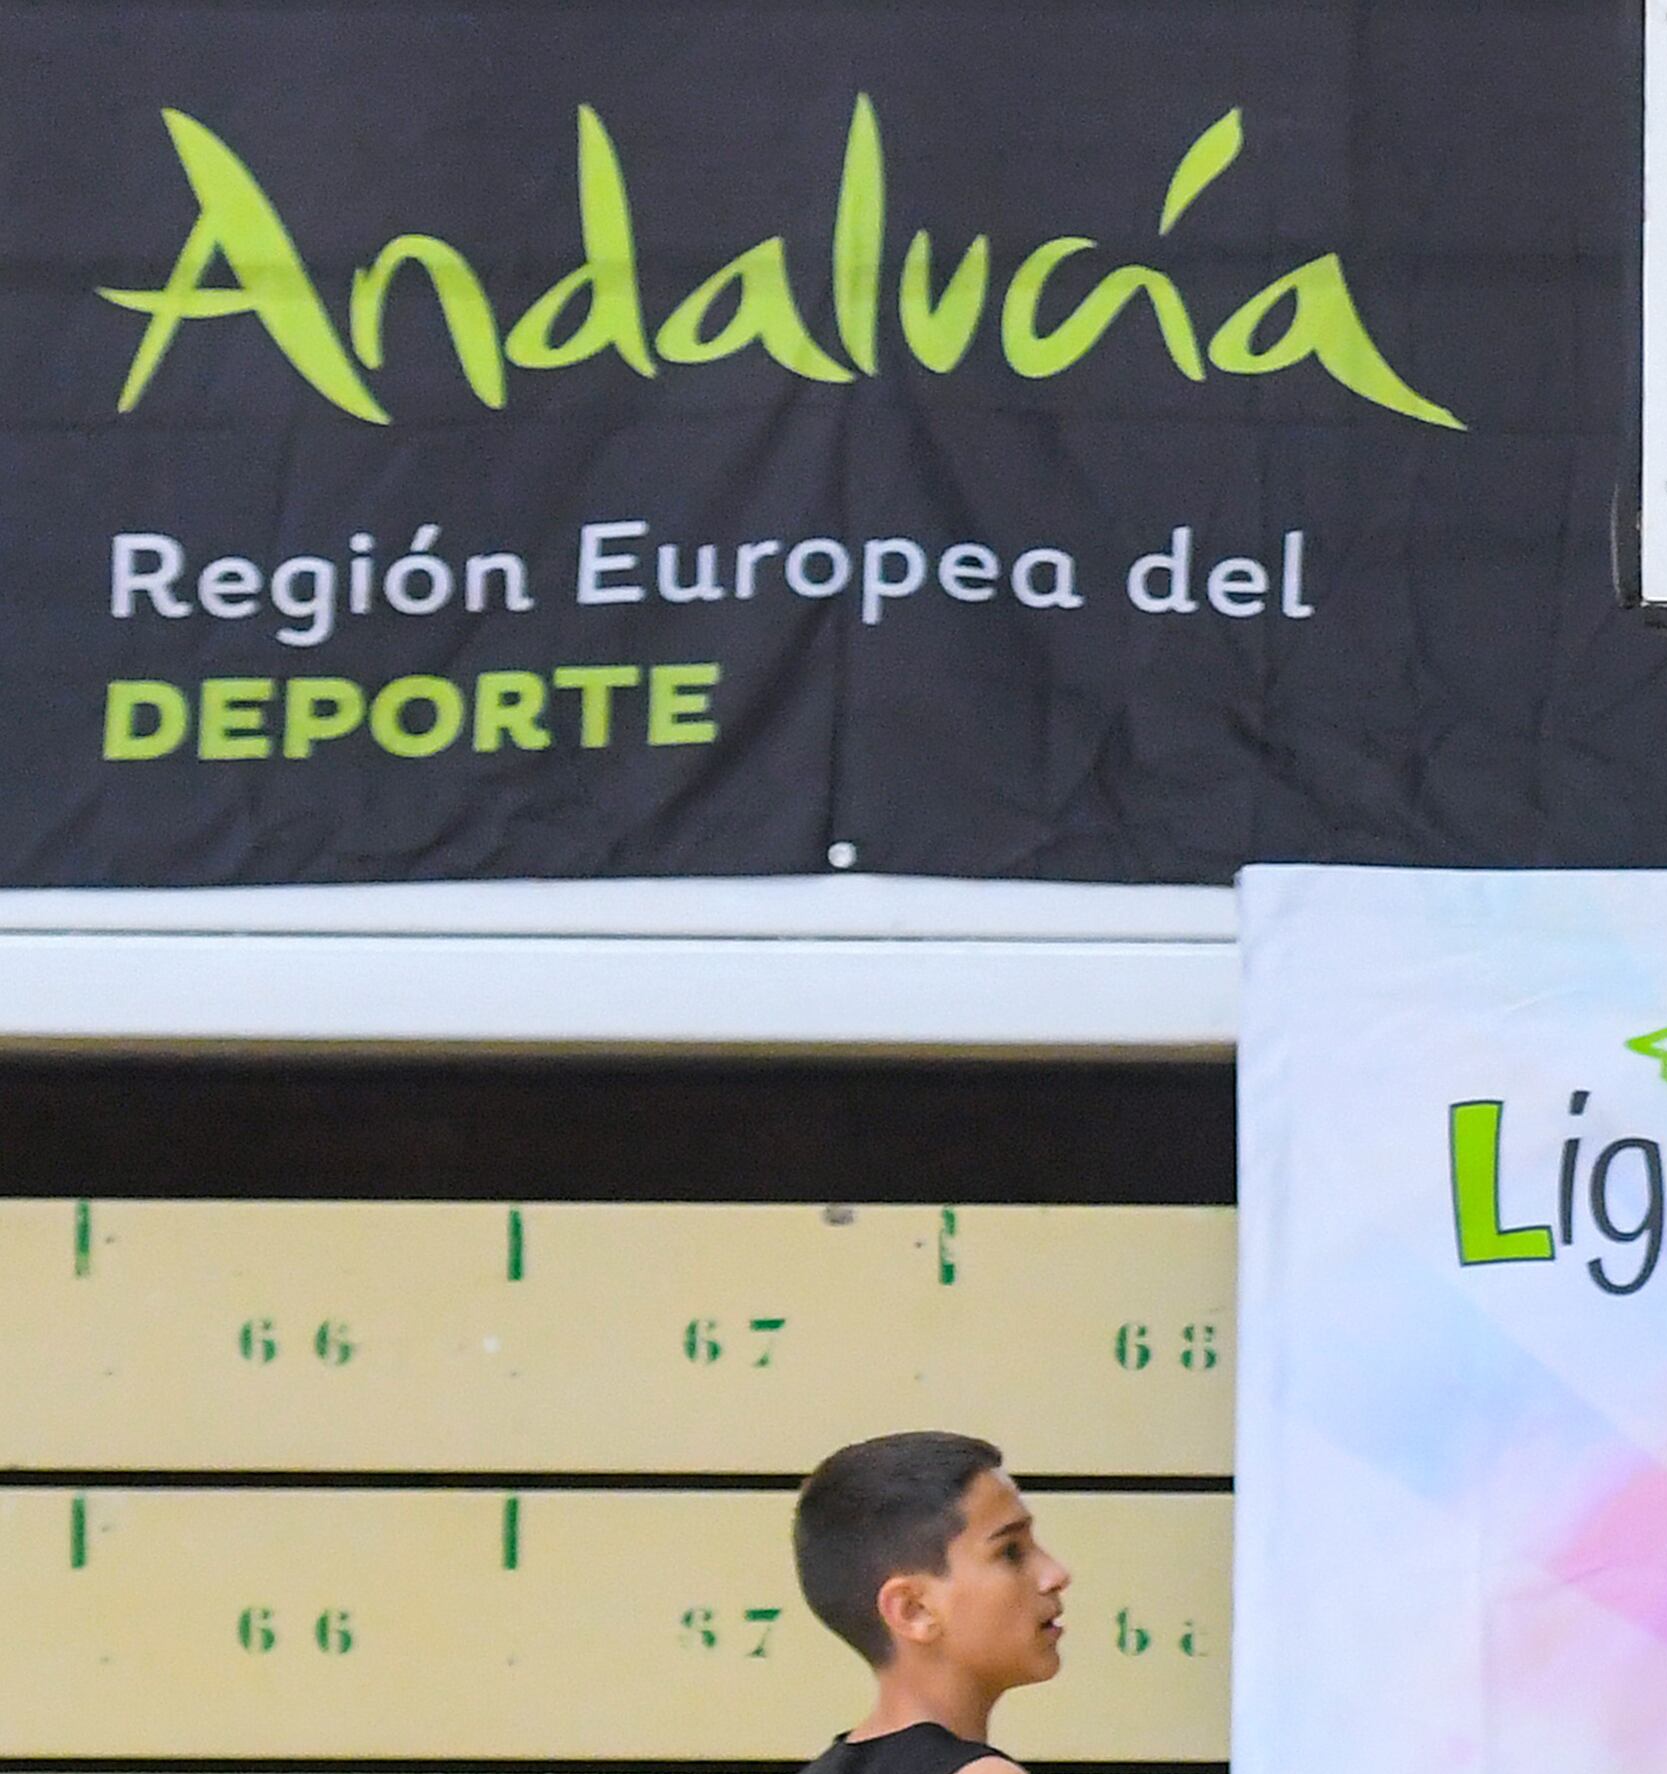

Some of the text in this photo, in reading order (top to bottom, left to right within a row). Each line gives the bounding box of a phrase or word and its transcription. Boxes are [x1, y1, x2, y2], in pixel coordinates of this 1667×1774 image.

[97, 92, 1468, 430] Andalucía
[111, 521, 1313, 646] Región Europea del
[105, 666, 715, 760] DEPORTE
[238, 1317, 354, 1366] 66
[684, 1316, 786, 1366] 67
[237, 1608, 354, 1656] 66
